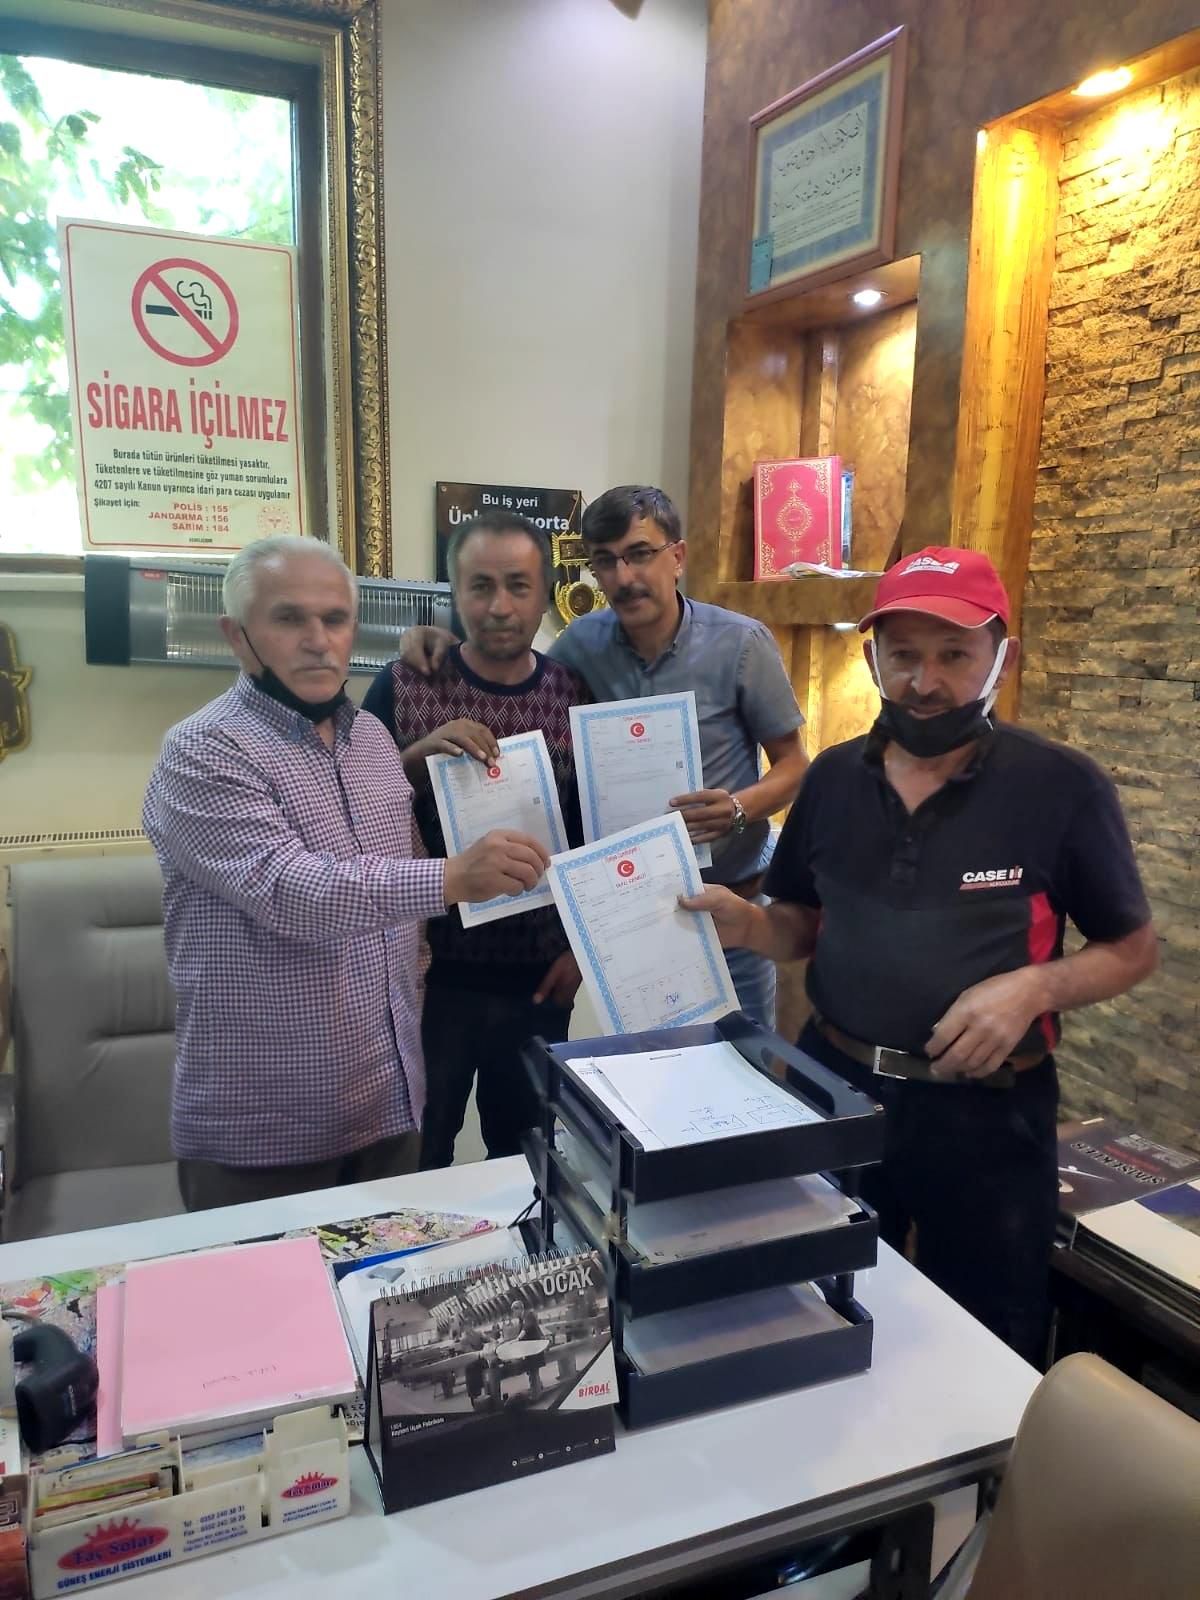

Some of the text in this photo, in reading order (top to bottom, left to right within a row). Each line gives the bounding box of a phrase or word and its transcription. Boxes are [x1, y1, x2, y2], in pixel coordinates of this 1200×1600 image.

[86, 370, 289, 450] SİGARA İÇİLMEZ
[113, 448, 270, 470] Burada tütün ürünleri tüketilmesi yasaktır.
[95, 463, 141, 475] Tüketenlere
[153, 465, 204, 479] tüketilmesine
[206, 470, 219, 482] göz
[220, 472, 244, 483] yuman
[245, 474, 288, 485] sorumlulara
[94, 479, 112, 490] 4207
[114, 480, 136, 492] sayılı
[137, 480, 162, 491] Kanun
[163, 483, 195, 495] uyarınca
[197, 485, 214, 495] idari
[216, 487, 233, 497] para
[234, 488, 257, 498] cezası
[94, 498, 122, 508] Şikayet
[173, 502, 203, 511] POLİS
[212, 505, 229, 513] 155
[482, 493, 538, 509] Bu iş yeri
[147, 511, 204, 522] JANDARMA
[212, 514, 229, 523] 156
[962, 869, 1008, 883] CASE
[57, 1548, 172, 1589] GÜNEŞ ENERJİ SİSTEMLERİ
